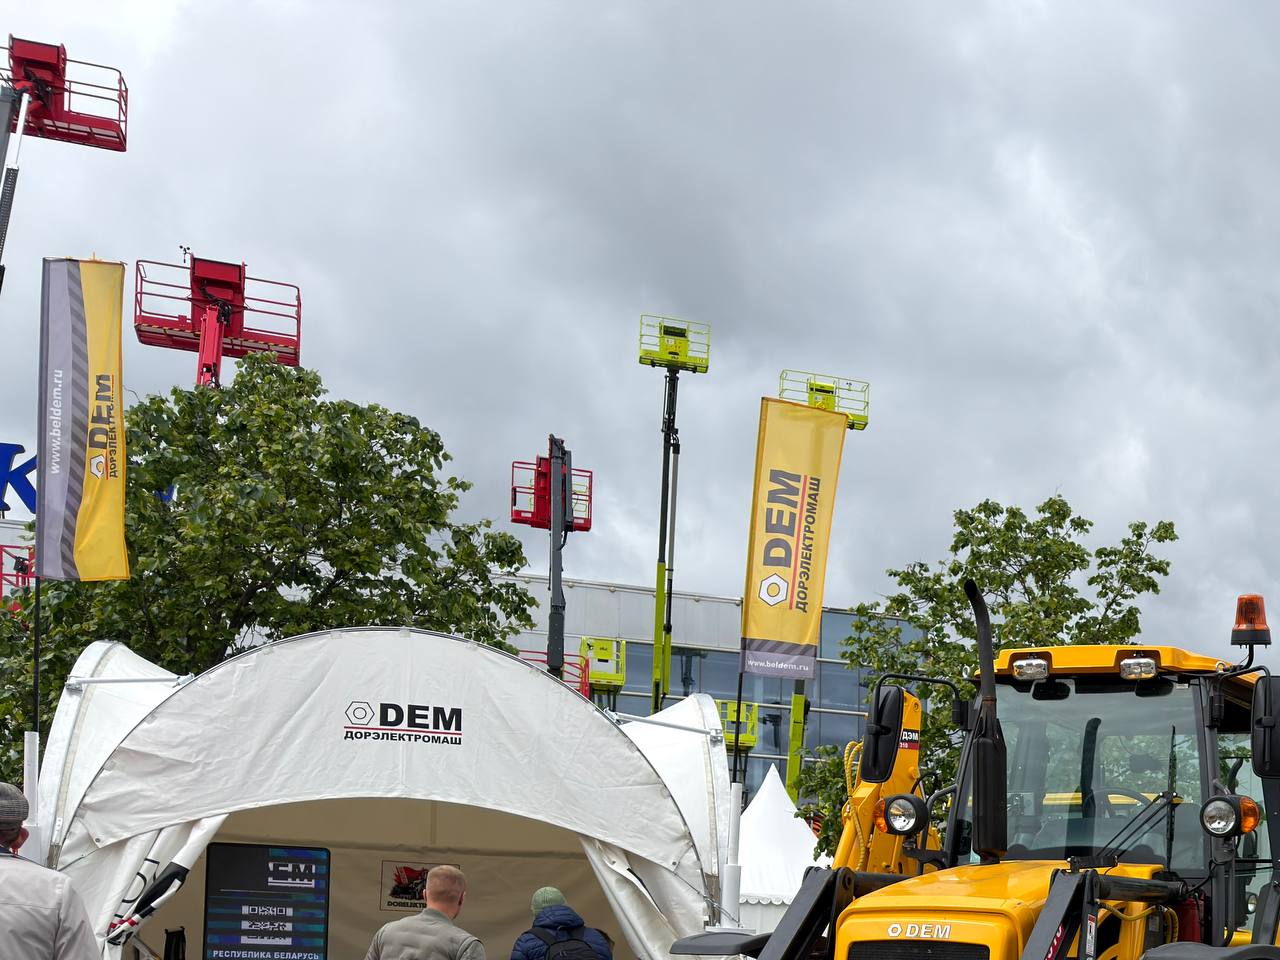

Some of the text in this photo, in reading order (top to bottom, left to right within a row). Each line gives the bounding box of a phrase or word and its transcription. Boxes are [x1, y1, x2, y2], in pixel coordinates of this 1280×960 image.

[50, 369, 62, 475] www.beldem.ru
[89, 374, 111, 449] DEM
[763, 468, 801, 568] DEM
[795, 476, 821, 614] ДОРЭЛЕКТРОМАШ
[747, 658, 809, 671] www.beldem.ru
[379, 702, 462, 732] DEM
[343, 730, 462, 746] ДОРЭЛЕКТРОМАШ
[906, 923, 951, 939] DEM
[212, 950, 320, 960] РЕСПУБЛИКА БЕЛАРУСЬ
